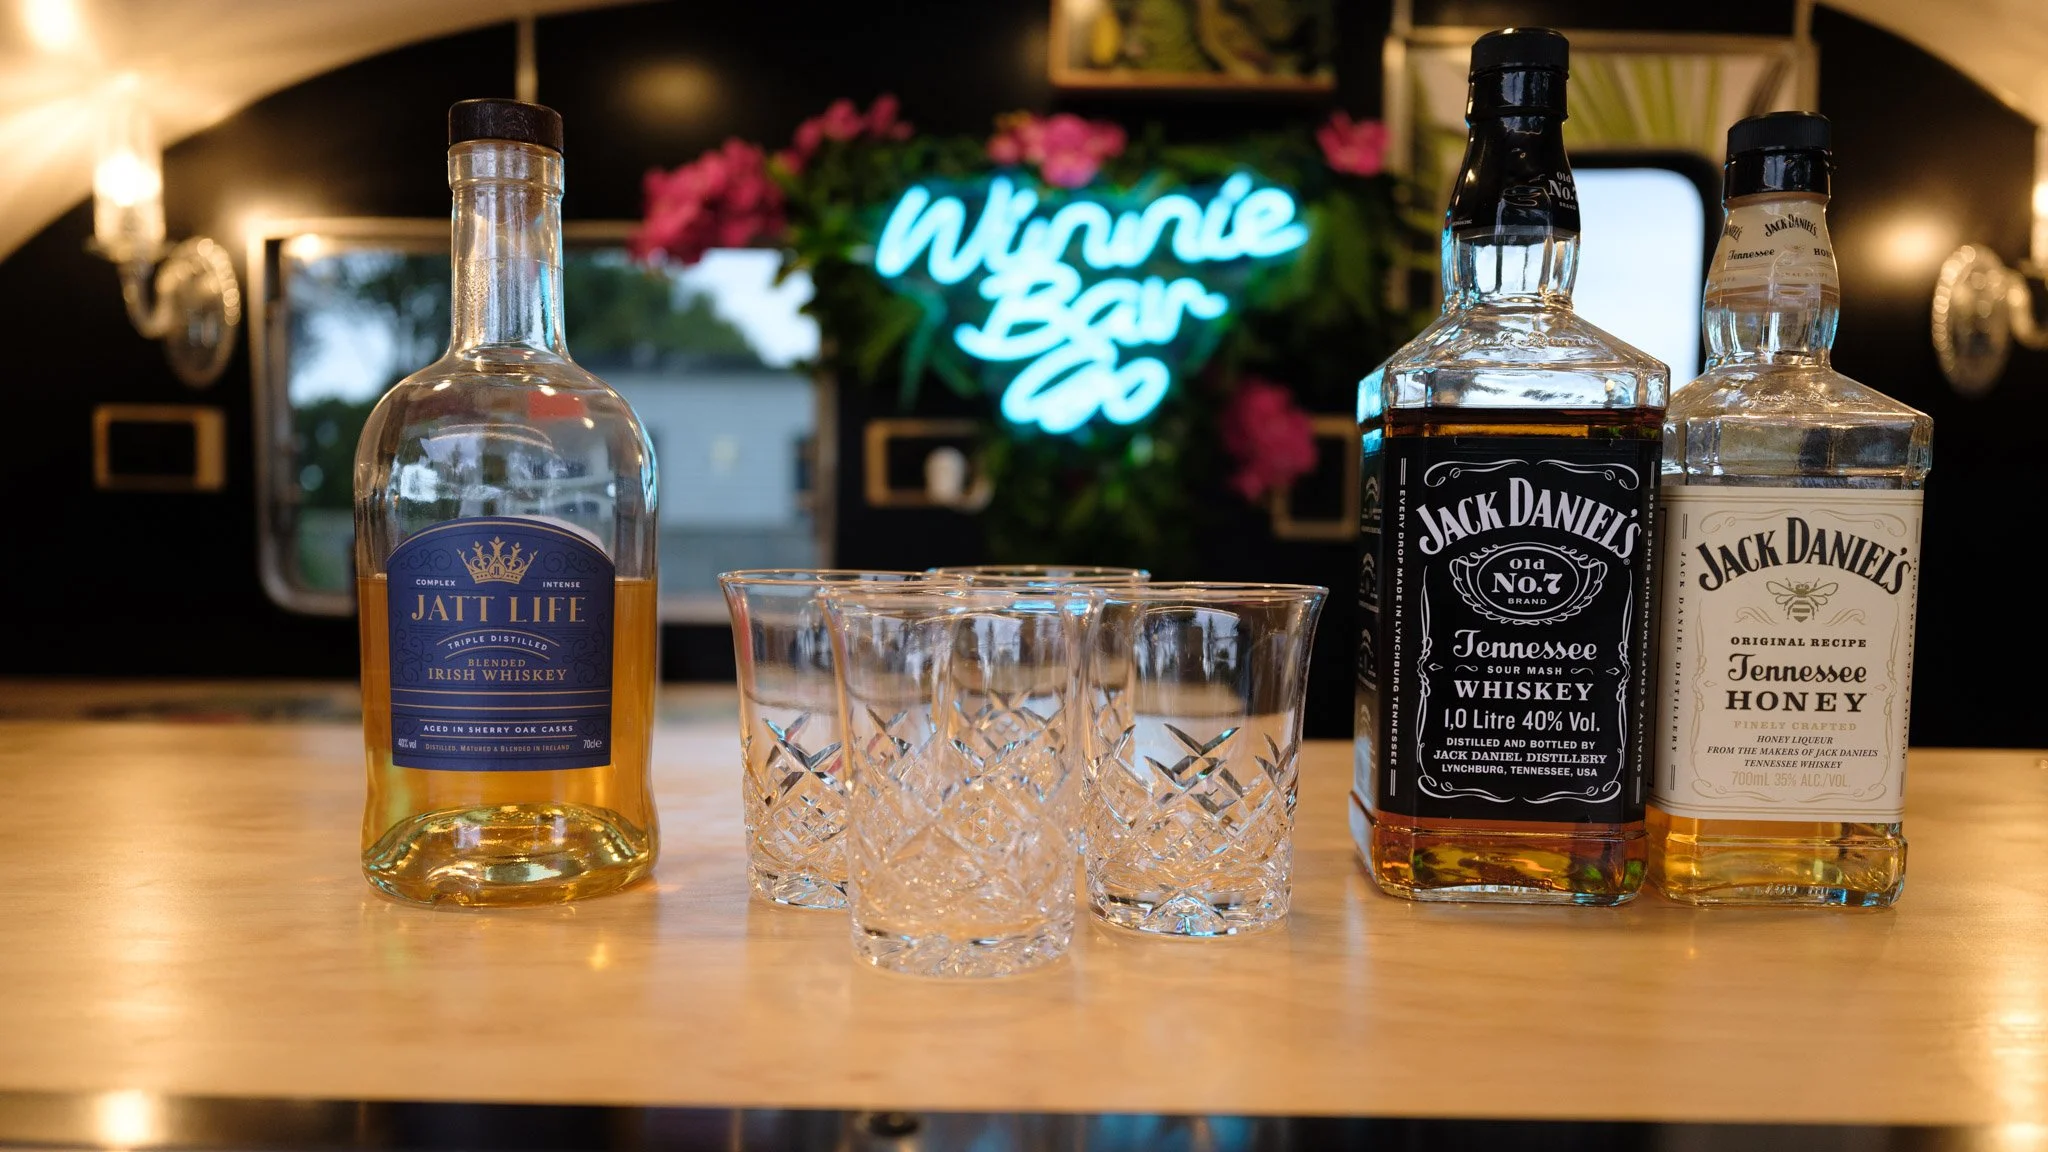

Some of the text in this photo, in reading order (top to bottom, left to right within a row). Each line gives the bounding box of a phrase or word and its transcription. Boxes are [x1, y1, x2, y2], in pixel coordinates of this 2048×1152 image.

[1556, 171, 1571, 183] Old
[875, 171, 1308, 284] Winnie
[1764, 213, 1818, 237] JACK DANIEL'S
[1727, 248, 1775, 261] Tennessee
[954, 260, 1228, 361] Bar
[1001, 338, 1170, 433] Go
[1416, 490, 1505, 555] JACK
[1508, 477, 1642, 559] DANIEL'S
[1695, 516, 1912, 595] JACK DANIEL'S
[1509, 558, 1546, 570] Old
[416, 578, 456, 587] COMPLEX
[1491, 572, 1563, 595] No.7
[411, 594, 586, 623] JATT LIFE
[1508, 597, 1547, 605] BRAND
[1390, 489, 1406, 766] EVERY DROP MADE IN LYNCHBURG TENNESSEE
[447, 634, 548, 651] TRIPLE DISTILLED
[1453, 629, 1597, 660] Tennessee
[1730, 636, 1867, 648] ORIGINAL RECIPE
[1671, 551, 1687, 753] JACK DANIEL DISTILLERY
[468, 659, 526, 667] BLENDED
[1487, 665, 1563, 675] SOUR MASH
[1728, 653, 1867, 683] Tennessee
[428, 668, 568, 682] IRISH WHISKEY
[1636, 713, 1644, 772] QUALITY
[1640, 576, 1650, 695] CRAFTSMANSHIP
[1453, 679, 1594, 701] WHISKEY
[1725, 690, 1868, 712] HONEY
[1444, 708, 1601, 732] 1,0 Litre 40% Vol.
[1733, 720, 1857, 731] FINELY CRAFTED
[423, 724, 448, 733] AGED
[541, 725, 573, 733] CASKS
[1446, 737, 1596, 750] DISTILLED AND BOTTLED BY
[1757, 735, 1834, 745] HONEY LIQUEUR
[1433, 750, 1608, 764] JACK DANIEL DISTILLERY
[1707, 745, 1735, 755] FROM
[1738, 747, 1757, 755] THE
[1759, 747, 1799, 756] MAKERS
[1801, 748, 1815, 757] OF
[1814, 748, 1838, 758] JACK
[1441, 763, 1598, 777] LYNCHBURG, TENNESSEE, USA
[1744, 759, 1843, 769] TENNESSEE WHISKEY
[1732, 771, 1770, 786] 700mL
[1774, 772, 1797, 787] 35%
